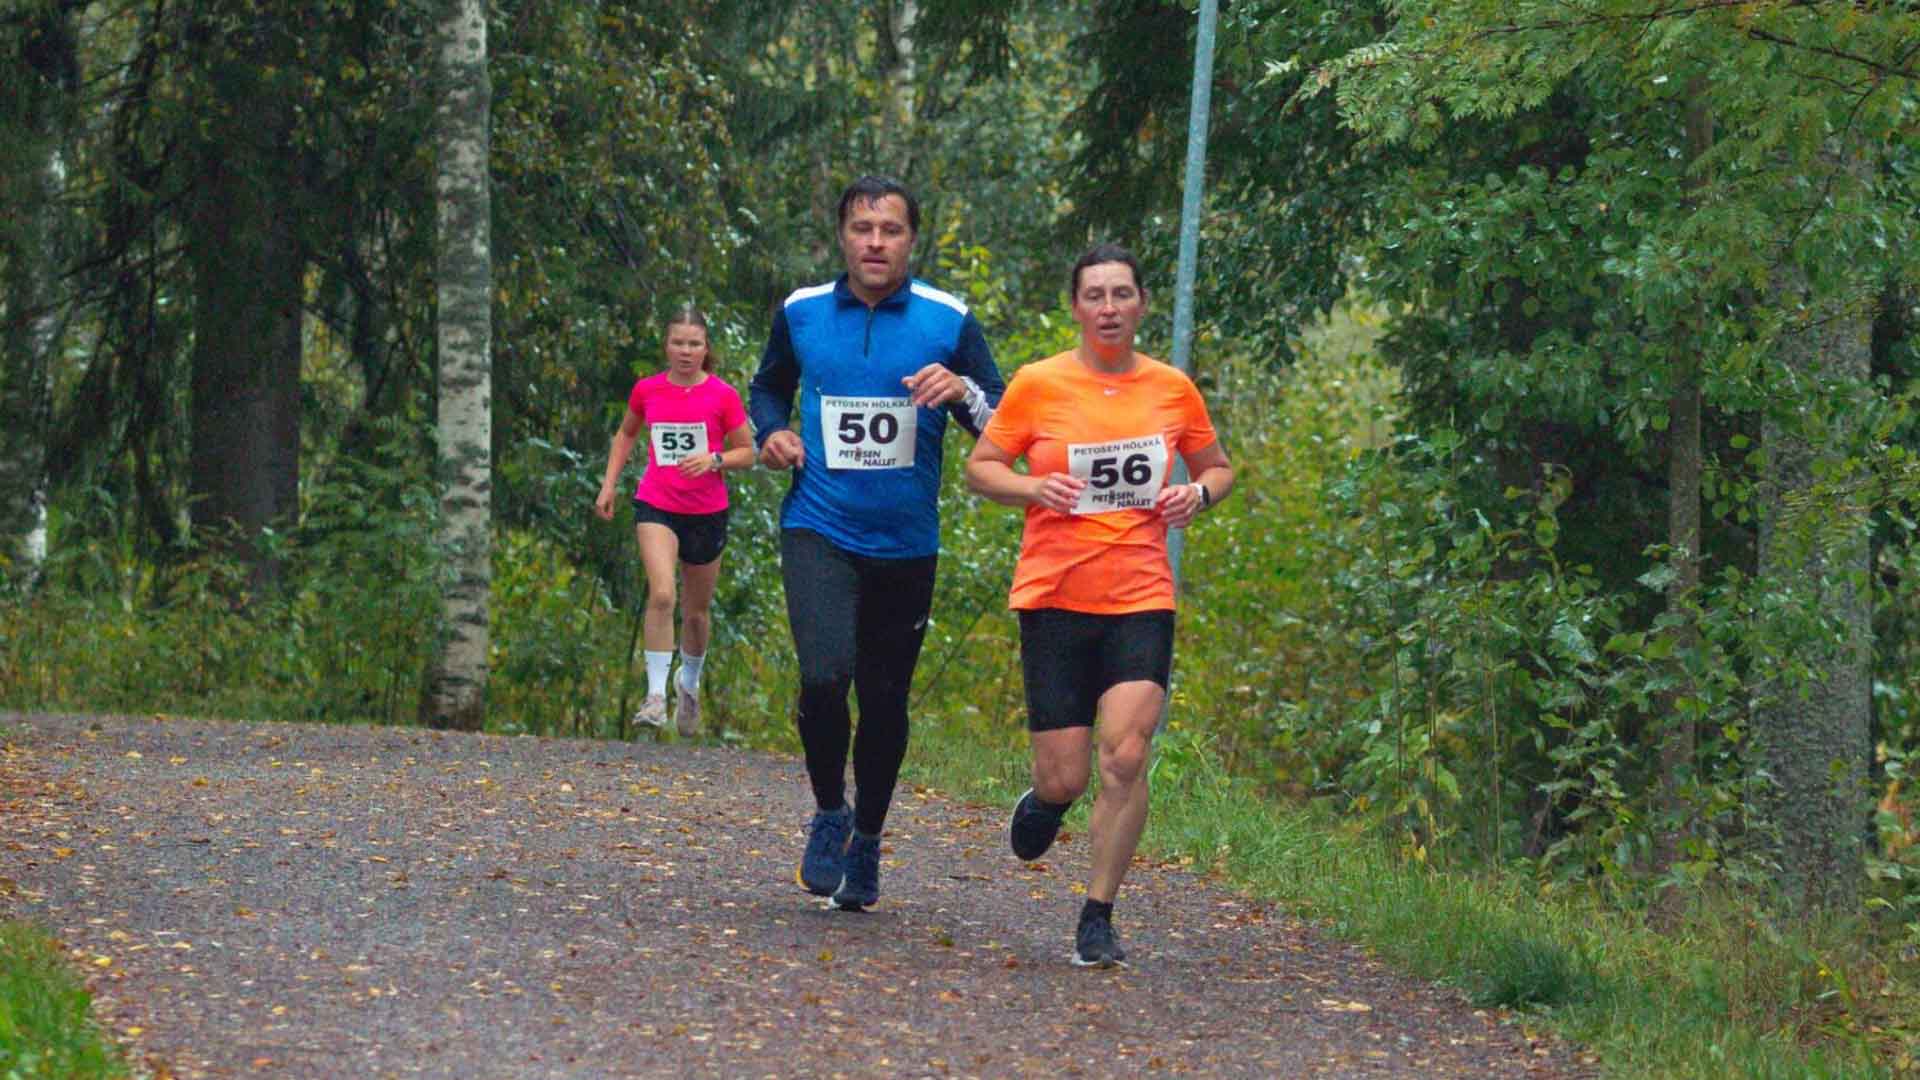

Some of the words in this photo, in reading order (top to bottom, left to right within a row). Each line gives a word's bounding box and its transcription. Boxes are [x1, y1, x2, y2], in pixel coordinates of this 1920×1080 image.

[826, 399, 868, 408] PETOSEN
[839, 413, 898, 444] 50
[662, 432, 695, 450] 53
[839, 447, 881, 461] PETSEN
[1075, 445, 1120, 455] PETOSEN
[1091, 454, 1151, 488] 56
[1092, 490, 1135, 504] PETSEN
